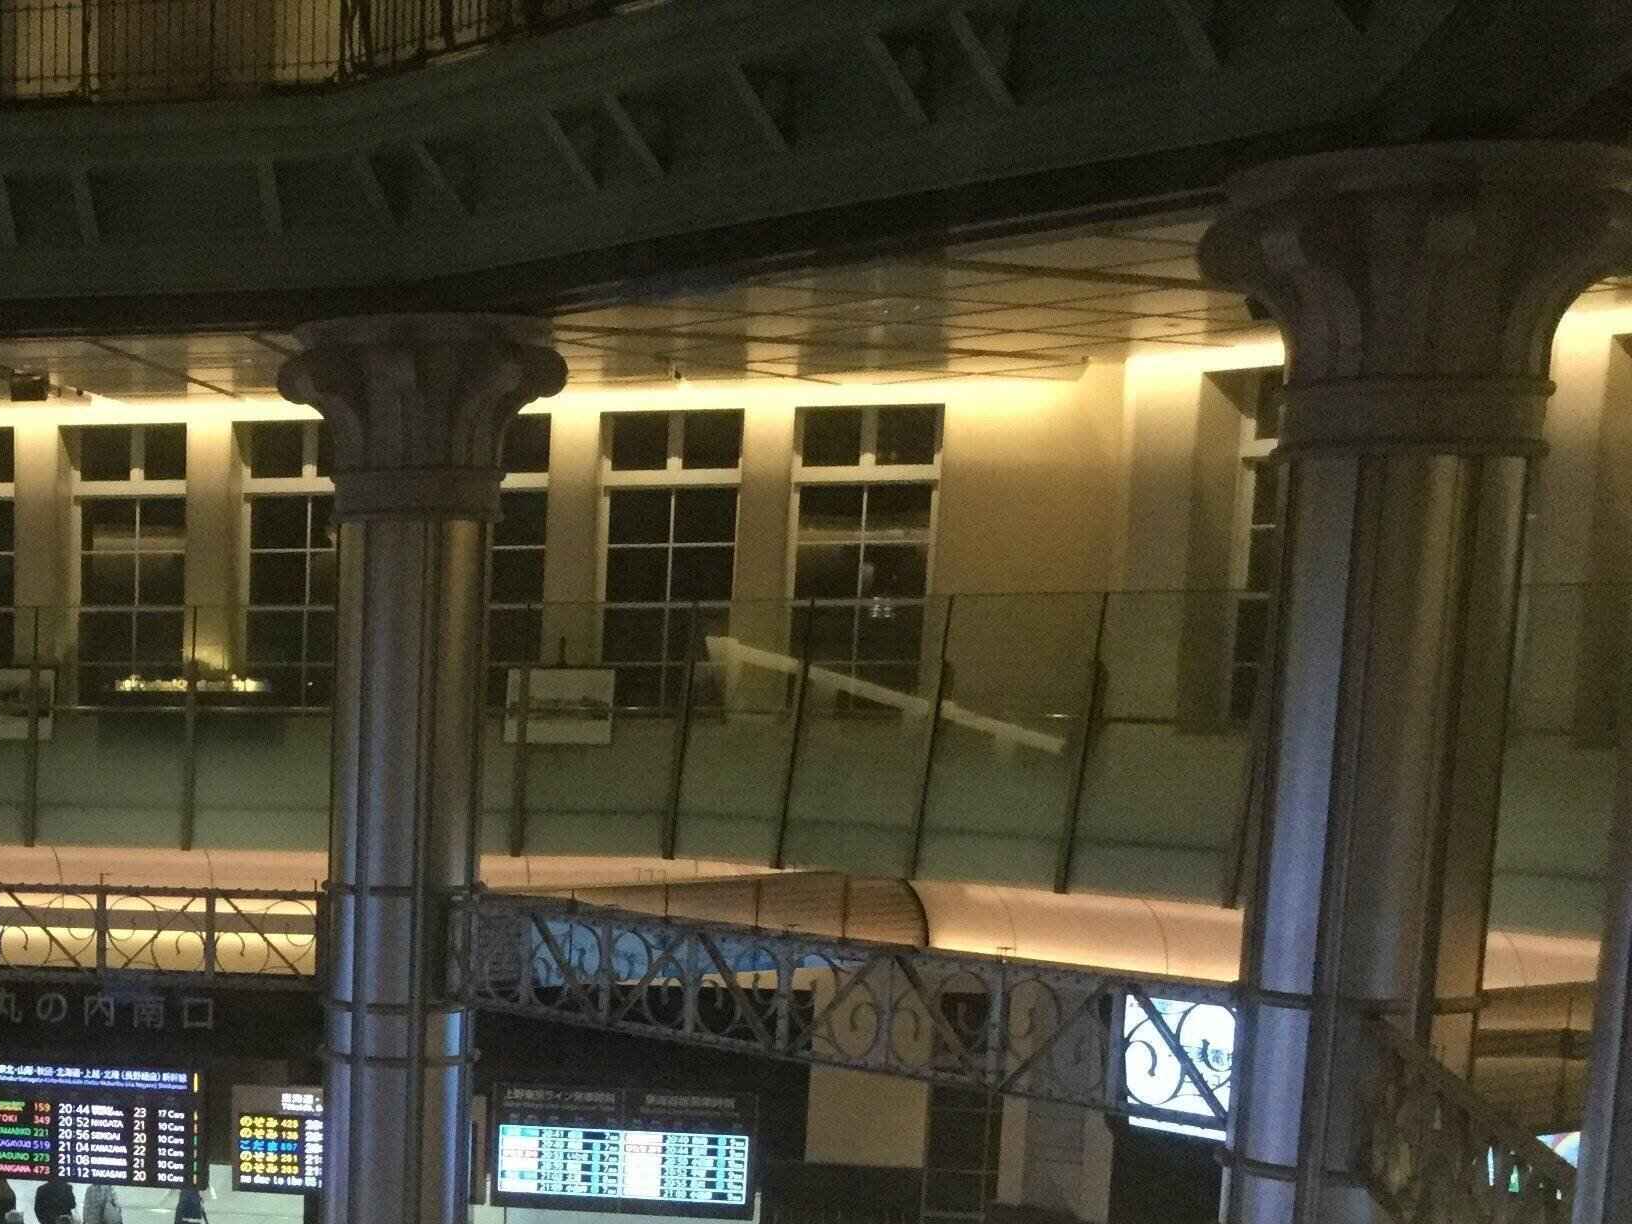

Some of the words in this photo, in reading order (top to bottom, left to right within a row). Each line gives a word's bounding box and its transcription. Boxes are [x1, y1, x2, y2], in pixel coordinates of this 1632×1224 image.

[58, 1103, 90, 1114] 20:44
[133, 1107, 146, 1118] 23
[133, 1120, 145, 1131] 21
[133, 1133, 146, 1143] 20
[32, 1140, 51, 1149] 519
[133, 1145, 146, 1156] 22
[133, 1158, 145, 1168] 21
[133, 1170, 146, 1181] 20
